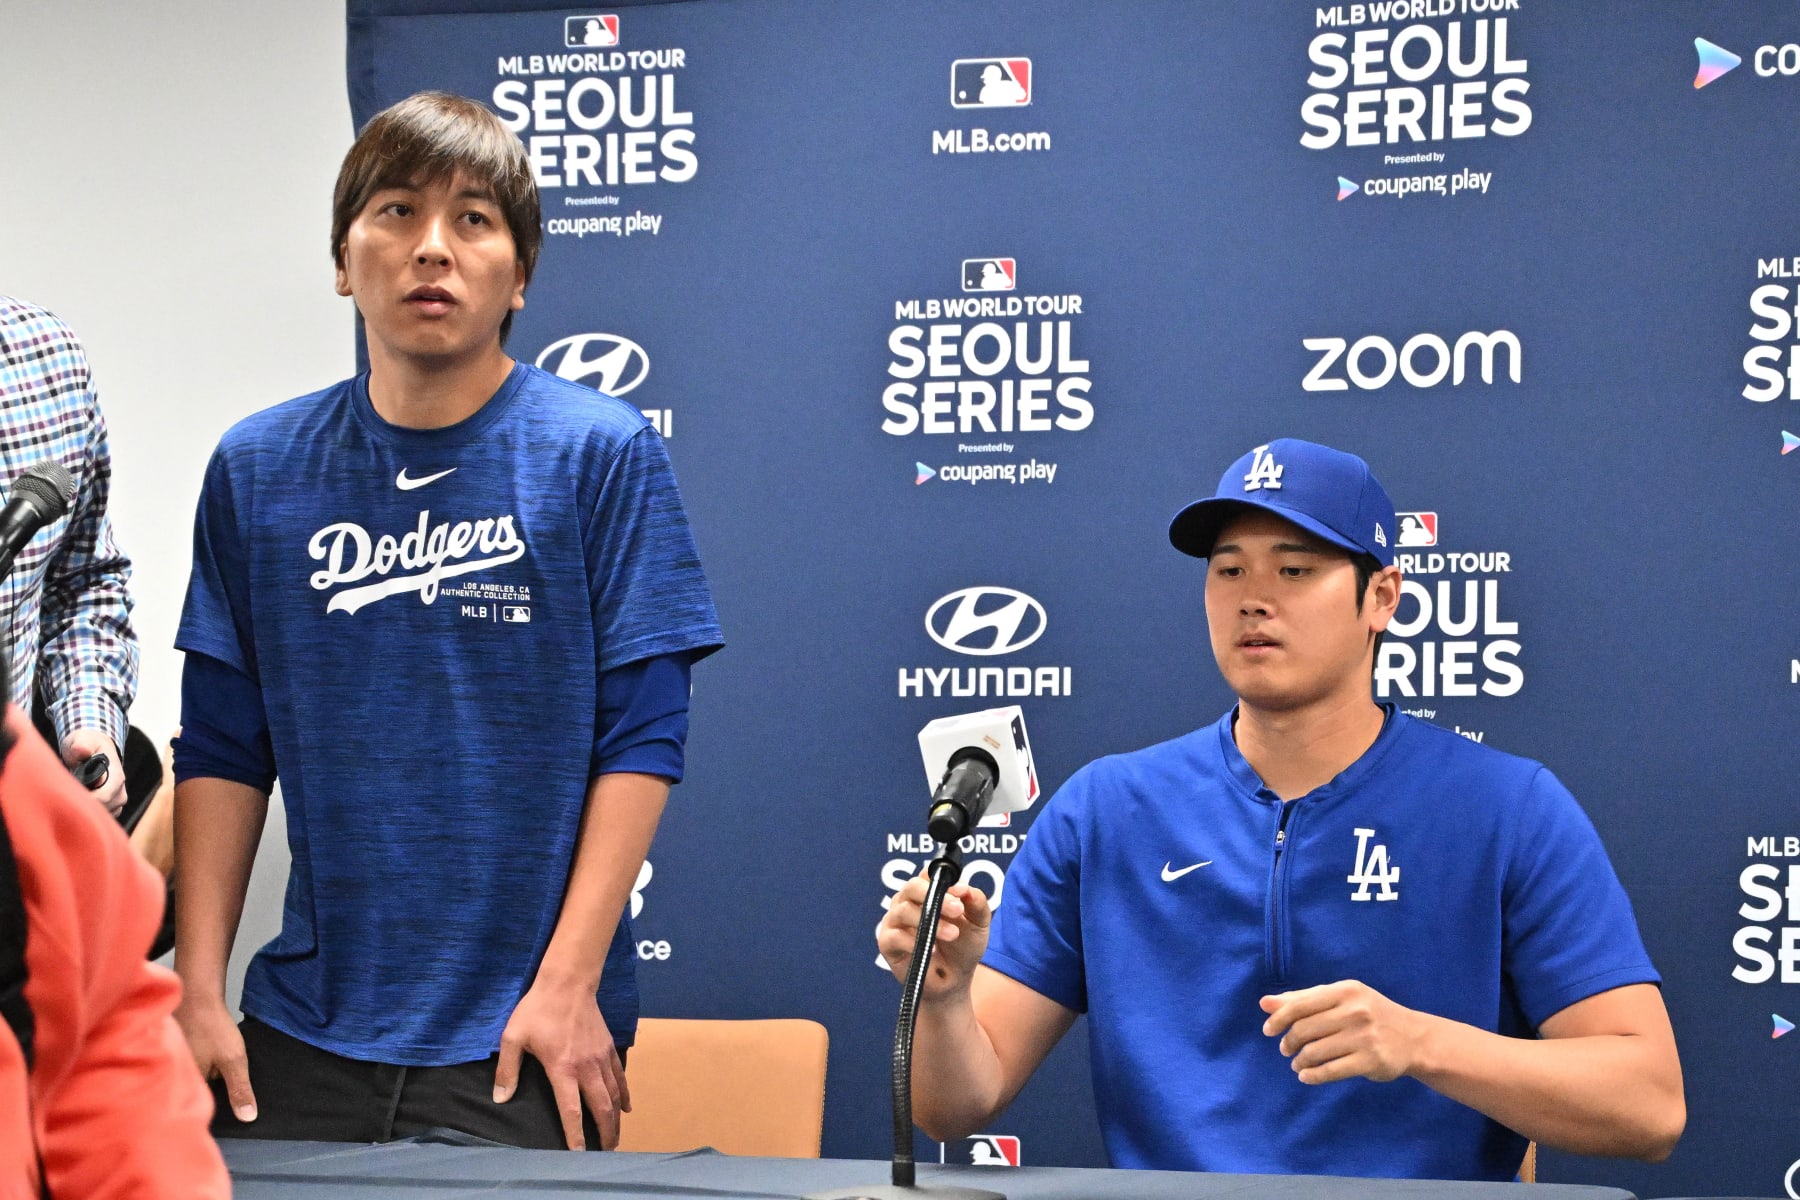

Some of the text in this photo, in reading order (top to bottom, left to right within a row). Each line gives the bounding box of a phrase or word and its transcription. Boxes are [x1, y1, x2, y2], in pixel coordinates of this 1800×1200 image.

[1315, 5, 1366, 28] MLB
[1368, 0, 1455, 23] WORLD
[498, 48, 686, 75] MLB WORLD TOUR
[1307, 17, 1528, 90] SEOUL
[492, 74, 694, 133] SEOUL
[1299, 77, 1532, 150] SERIES
[932, 128, 1051, 155] MLB.com
[525, 128, 699, 188] ERIES
[1384, 151, 1445, 165] Presented by
[1364, 167, 1492, 199] coupang play
[564, 195, 620, 206] Presented by
[547, 210, 662, 238] coupang play
[895, 294, 1083, 320] MLB WORLD TOUR
[887, 320, 1090, 379] SEOUL
[881, 376, 1095, 436] SERIES
[958, 442, 1014, 453] Presented by
[939, 458, 1058, 485] coupang play
[1243, 444, 1284, 492] LA
[307, 509, 526, 616] Dodgers
[1394, 551, 1511, 574] RLD TOUR
[440, 587, 531, 601] AUTHENTIC COLLECTION
[463, 582, 477, 590] LOS
[519, 586, 530, 594] CA
[461, 605, 487, 618] MLB
[1386, 579, 1519, 637] OUL
[898, 666, 1072, 697] HYUNDAI
[1374, 639, 1524, 697] RIES
[1424, 708, 1436, 719] by
[887, 833, 935, 853] MLB
[938, 833, 1018, 853] ORLD
[1747, 836, 1800, 857] MLB
[1347, 827, 1400, 902] LA
